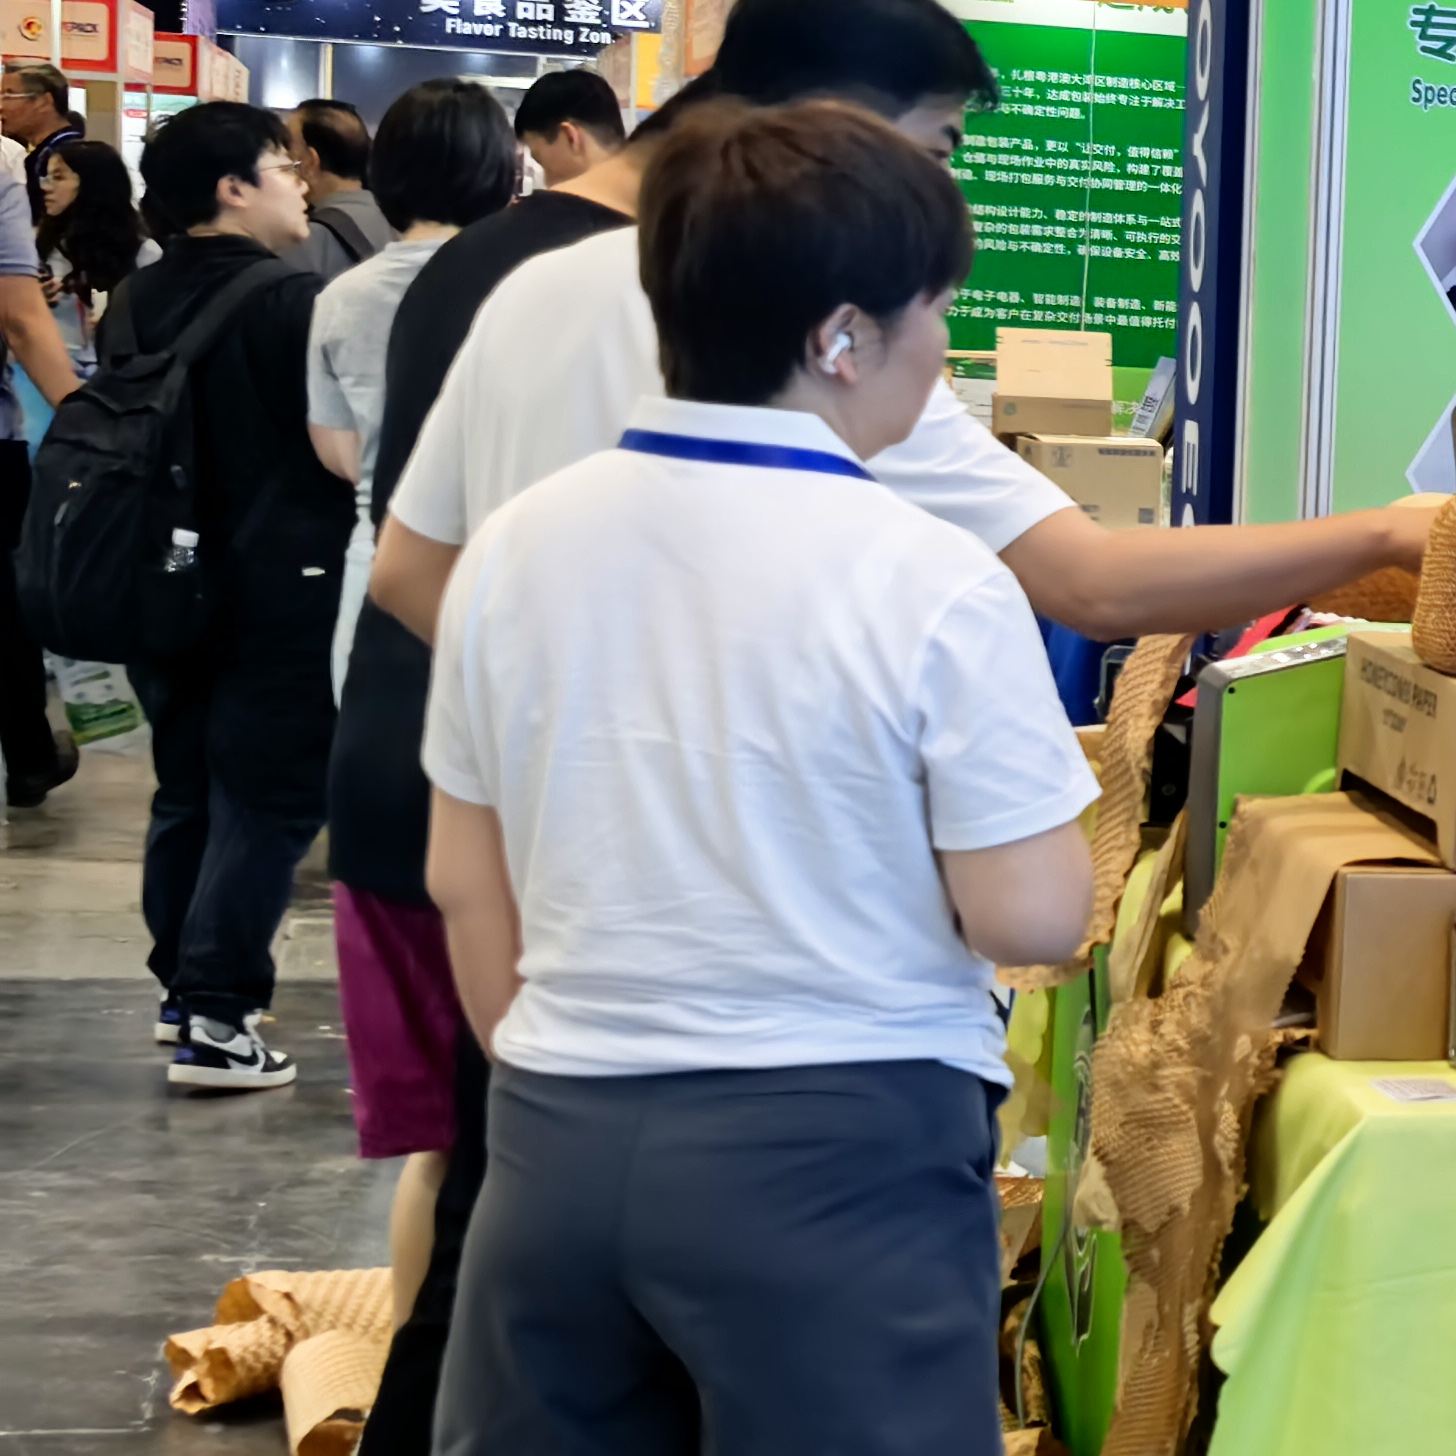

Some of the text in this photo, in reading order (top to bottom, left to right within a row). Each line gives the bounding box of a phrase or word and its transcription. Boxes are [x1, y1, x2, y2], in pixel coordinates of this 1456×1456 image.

[445, 18, 615, 44] Flavor Tasting Zon
